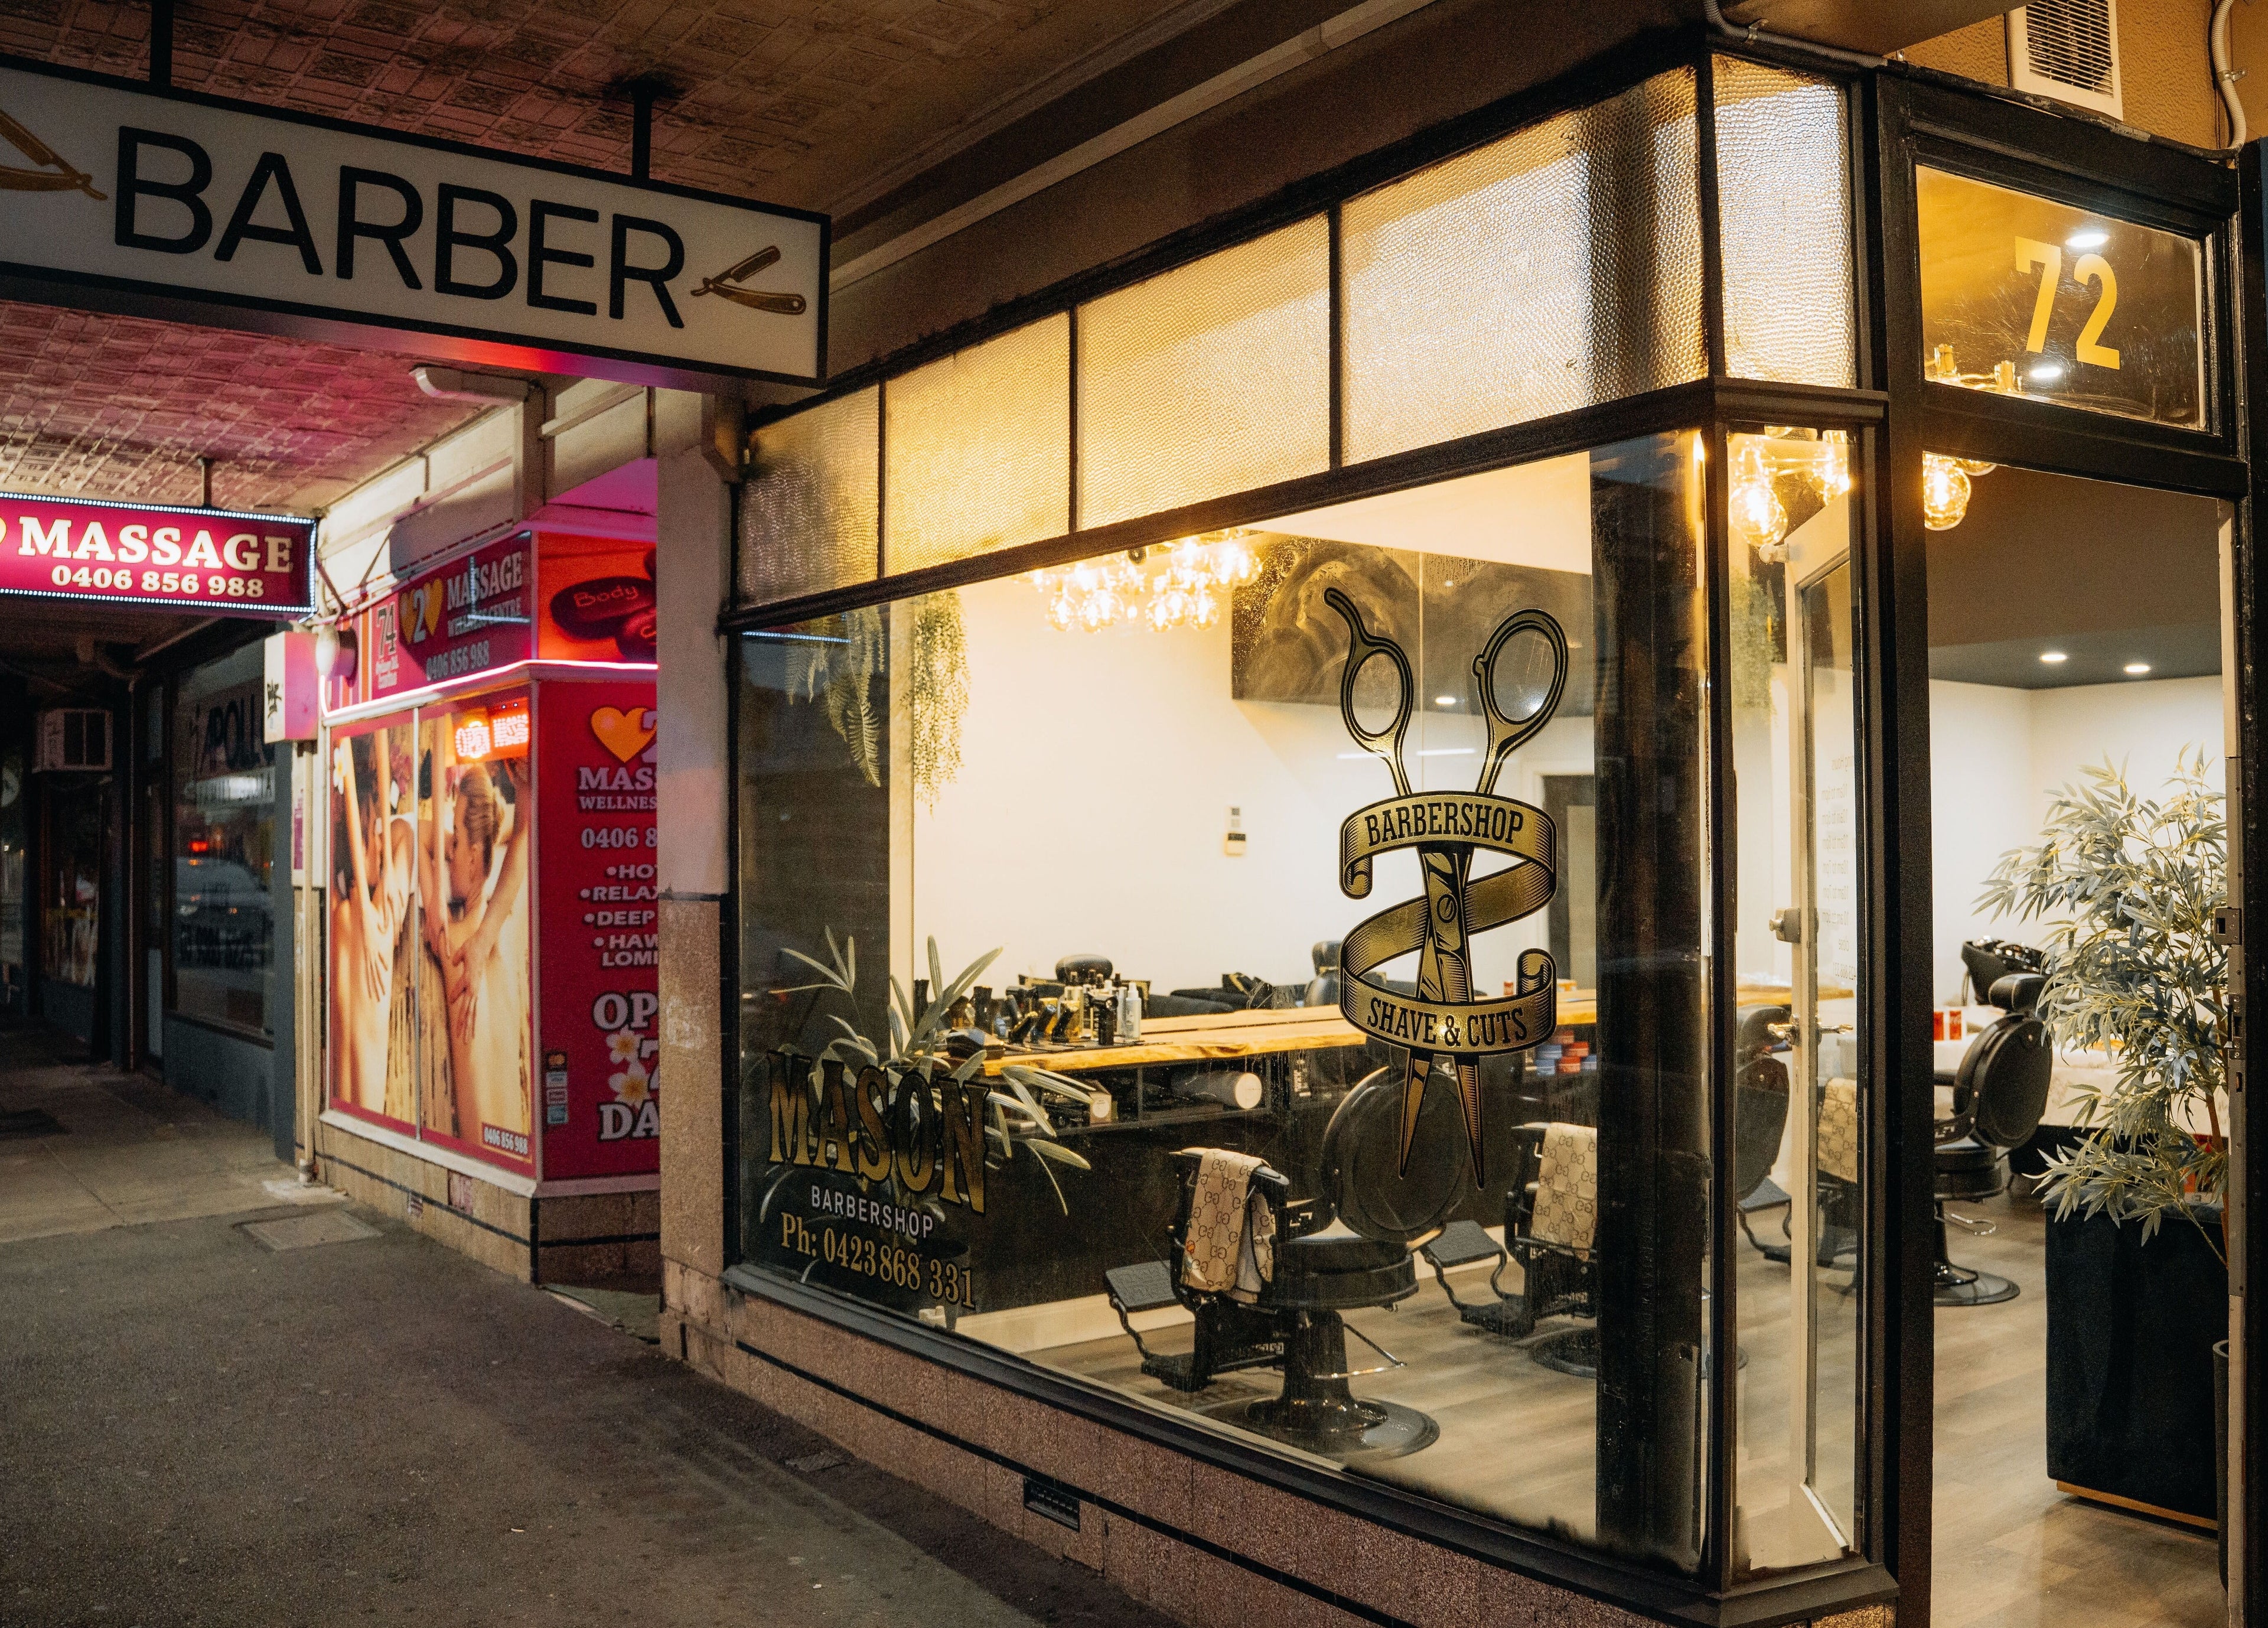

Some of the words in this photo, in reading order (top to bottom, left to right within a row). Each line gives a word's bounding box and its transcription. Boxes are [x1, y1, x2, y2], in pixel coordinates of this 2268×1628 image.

[115, 125, 685, 329] BARBER
[2015, 236, 2120, 370] 72
[18, 516, 293, 572] MASSAGE
[51, 565, 133, 590] 0406
[141, 571, 200, 594] 856
[207, 575, 265, 598] 988
[573, 585, 638, 607] Body
[377, 601, 397, 659] 74
[413, 588, 426, 643] 2
[578, 767, 657, 791] MAS
[581, 827, 639, 848] 0406
[1364, 802, 1524, 847] BARBERSHOP
[597, 910, 656, 926] DEEP
[1367, 997, 1438, 1045] SHAVE
[1444, 1014, 1461, 1047] &
[1467, 1007, 1528, 1046] CUTS
[768, 1049, 990, 1217] MASON
[811, 1185, 934, 1239] BARBERSHOP
[780, 1212, 817, 1258] Ph:
[929, 1258, 976, 1310] 331
